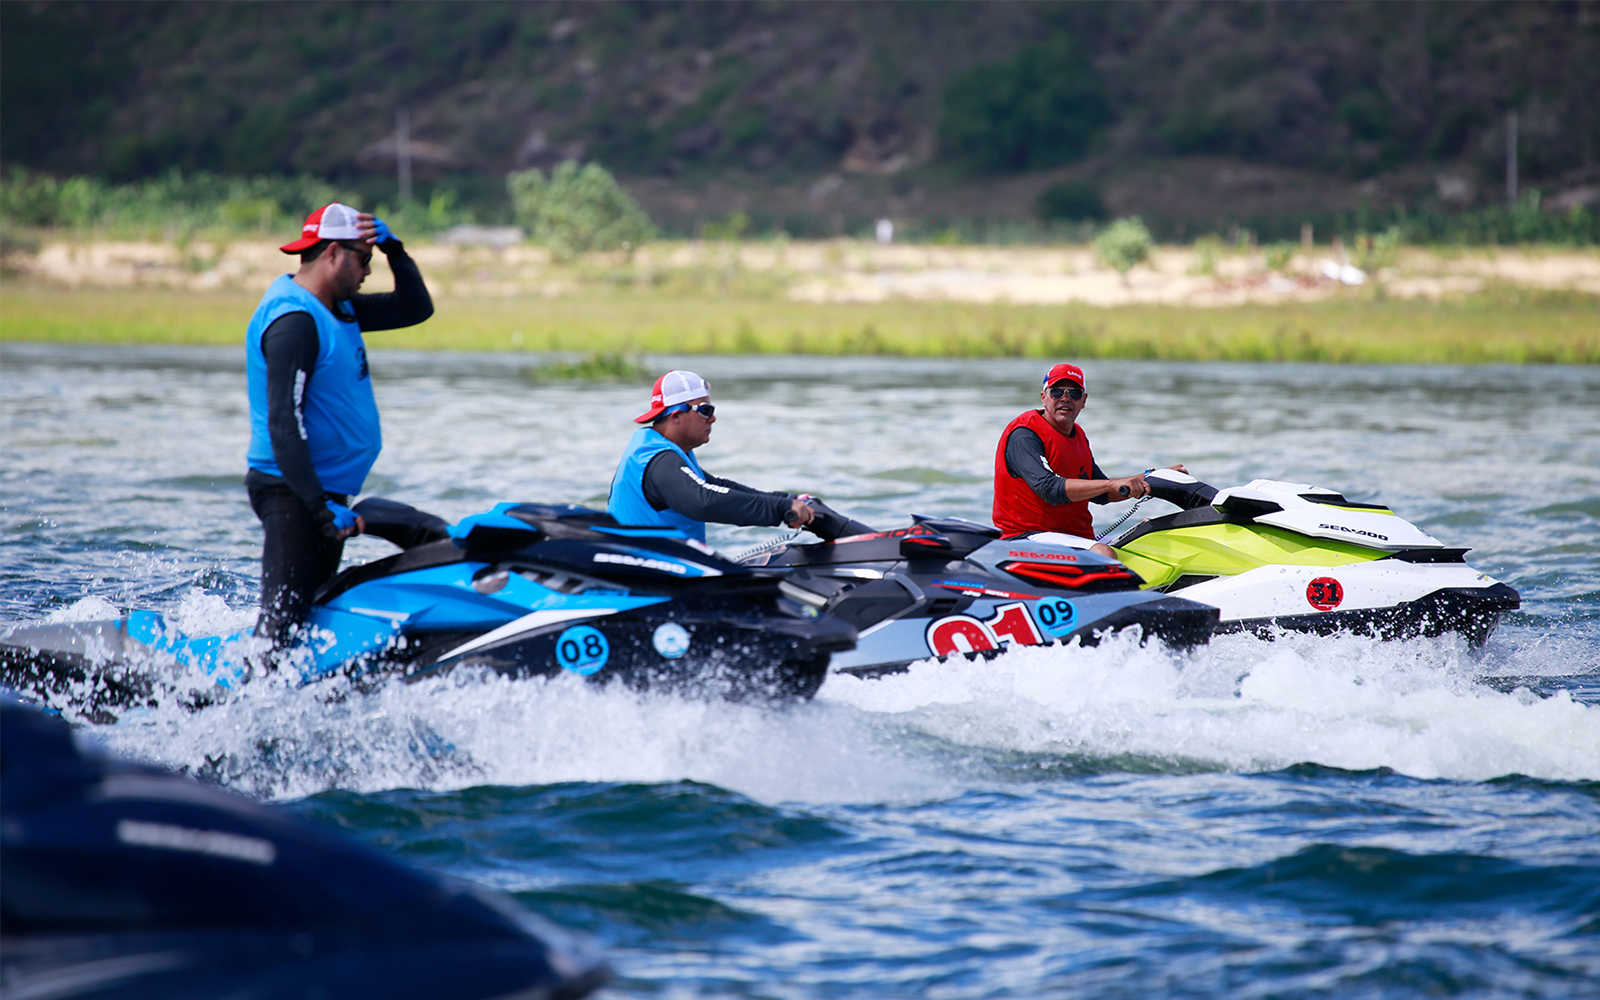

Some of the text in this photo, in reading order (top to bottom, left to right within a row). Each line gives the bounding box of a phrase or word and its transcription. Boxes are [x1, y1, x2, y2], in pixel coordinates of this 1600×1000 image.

[1310, 582, 1340, 602] 31
[1038, 600, 1074, 627] 09
[561, 634, 604, 663] 08
